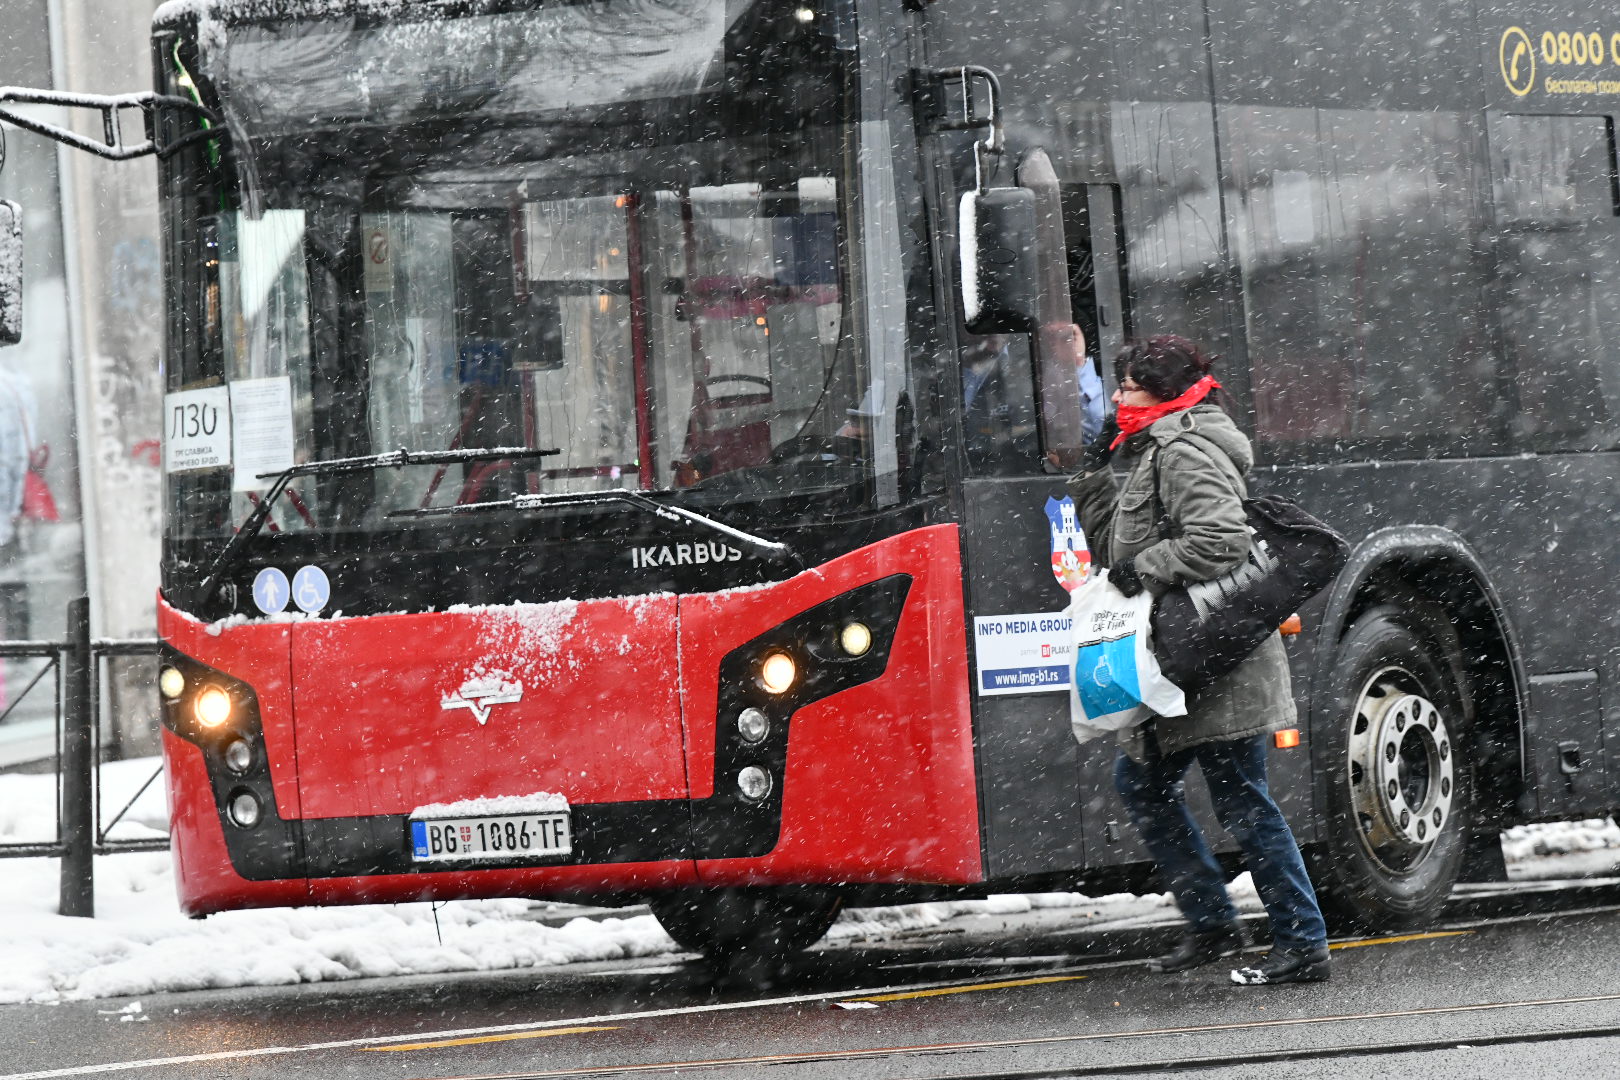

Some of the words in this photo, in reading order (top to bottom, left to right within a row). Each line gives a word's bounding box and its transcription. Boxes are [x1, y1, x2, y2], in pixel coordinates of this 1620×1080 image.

[1541, 31, 1604, 65] 0800
[631, 541, 742, 568] IKARBUS
[978, 622, 1003, 636] INFO
[1005, 620, 1038, 635] MEDIA
[1040, 618, 1073, 632] GROUP
[1051, 645, 1072, 655] PLAKA
[995, 669, 1059, 685] www.img-b1.rs
[430, 825, 457, 854] BG
